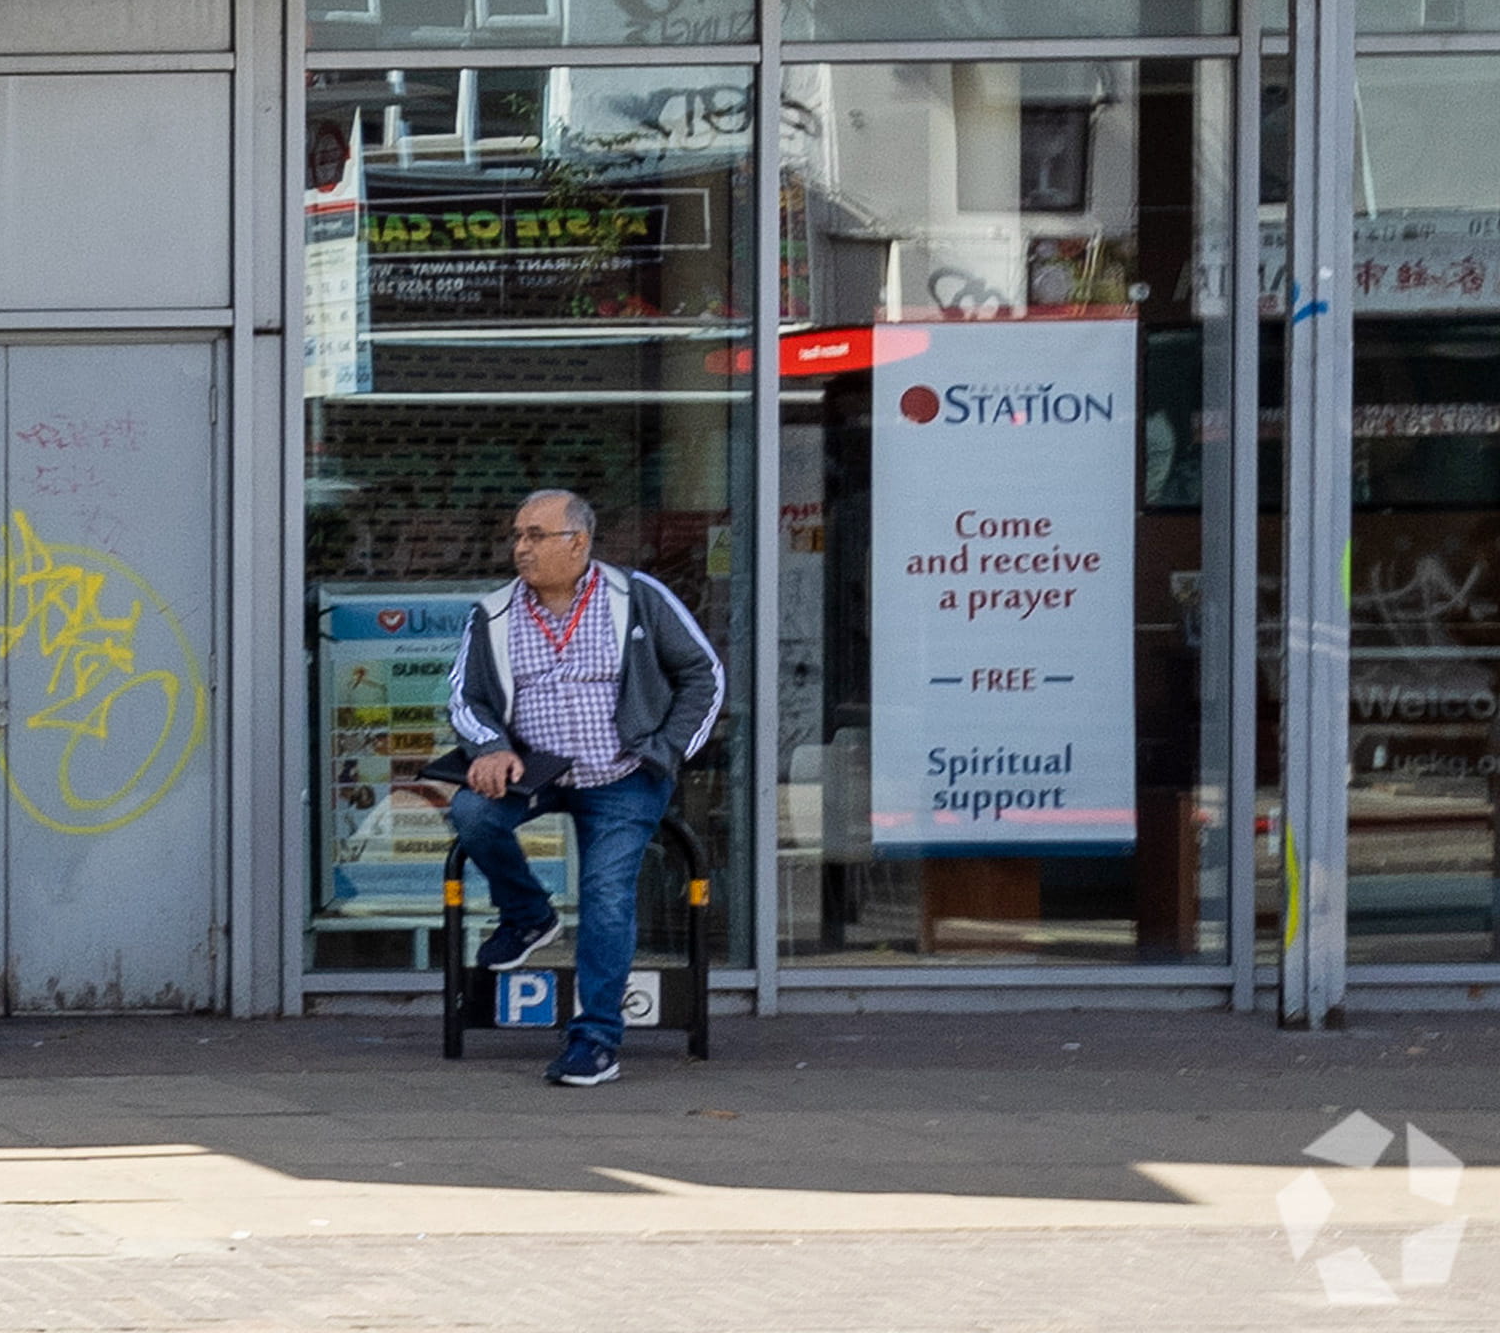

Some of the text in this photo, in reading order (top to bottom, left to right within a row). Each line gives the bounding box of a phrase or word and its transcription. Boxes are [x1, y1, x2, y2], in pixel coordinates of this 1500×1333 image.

[954, 511, 1053, 539] Come
[906, 545, 1102, 576] and receive
[938, 585, 1078, 621] a prayer
[971, 668, 1038, 692] FREE
[927, 743, 1073, 785] Spiritual
[932, 784, 1067, 823] support
[510, 974, 548, 1021] P
